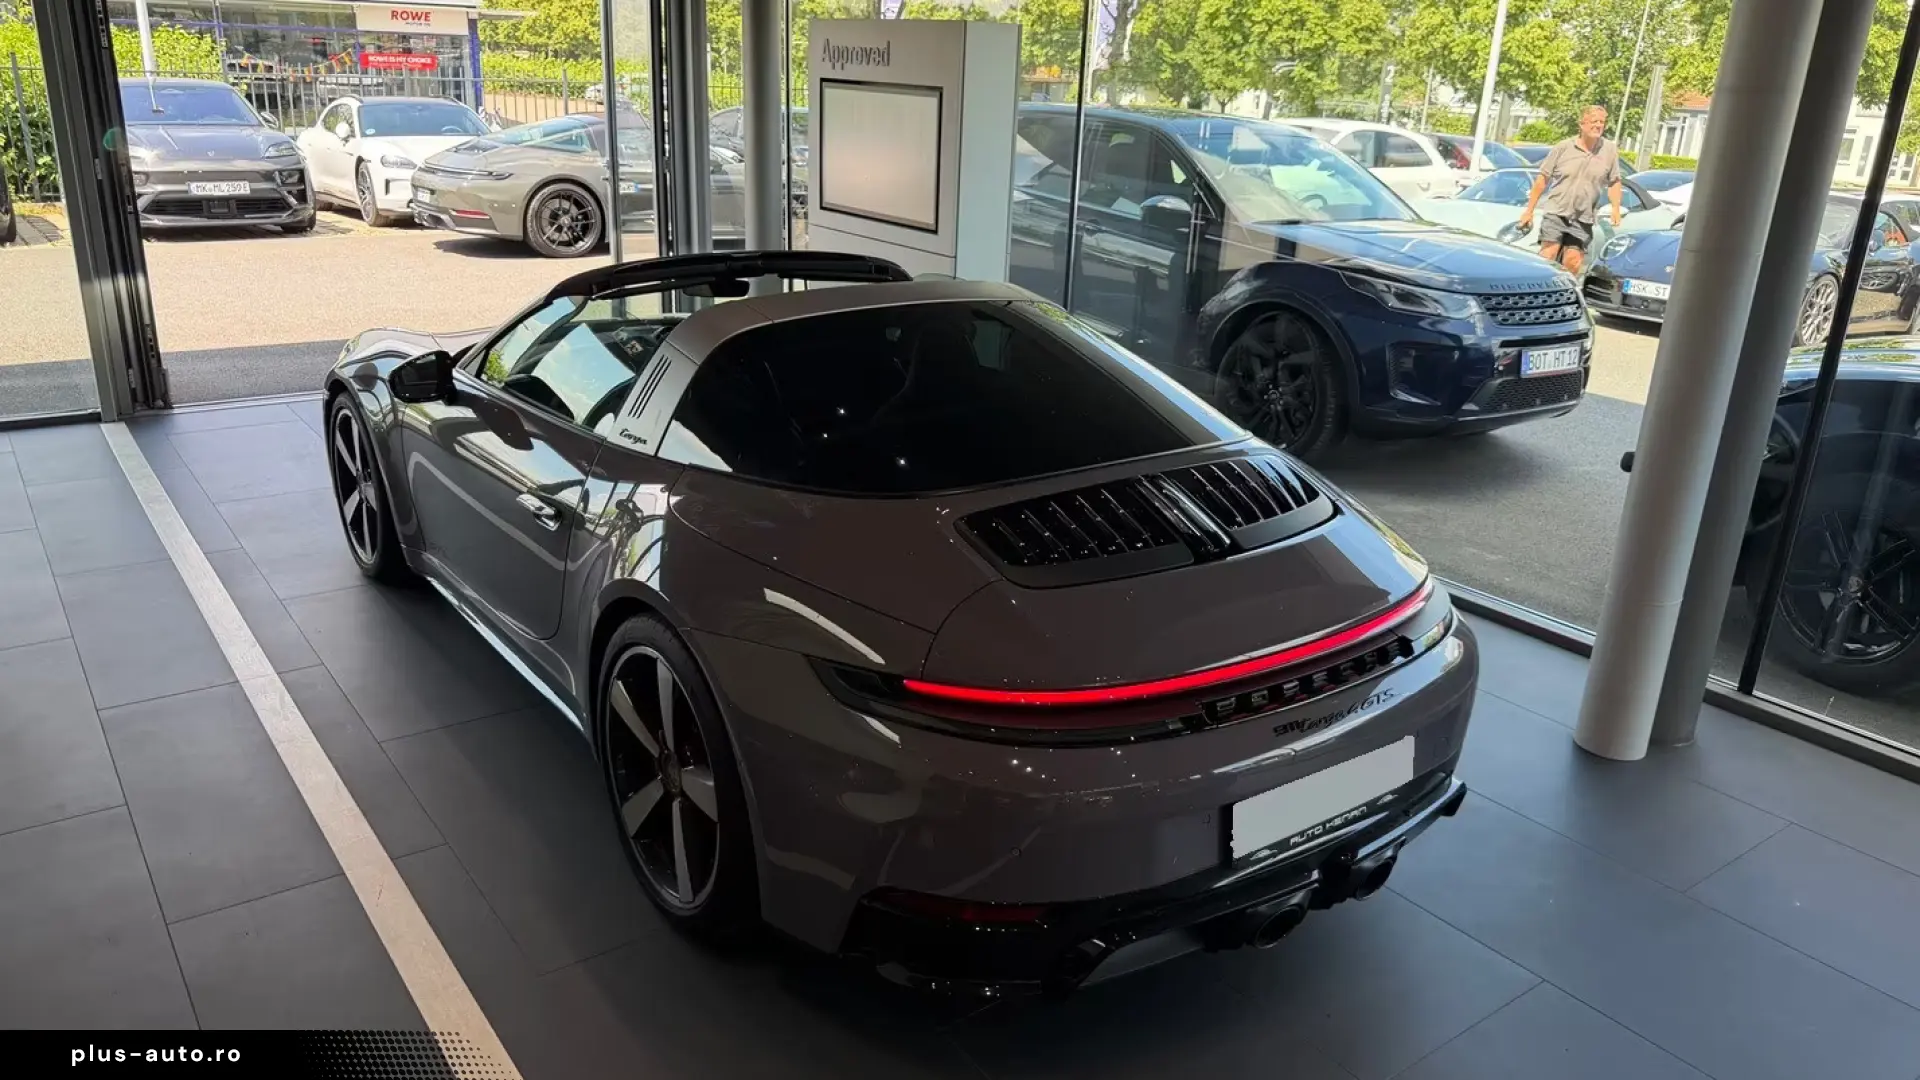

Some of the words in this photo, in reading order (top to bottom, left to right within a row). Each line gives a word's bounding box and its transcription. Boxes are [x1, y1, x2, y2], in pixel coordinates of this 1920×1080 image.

[390, 10, 432, 21] ROWE
[822, 38, 891, 70] Approved
[1529, 353, 1547, 370] BOT
[1553, 351, 1566, 366] HT
[1567, 349, 1578, 366] 12
[619, 428, 648, 445] Targa
[1360, 688, 1395, 712] GTS
[1290, 825, 1323, 846] AUTO
[1325, 806, 1367, 829] KENAN
